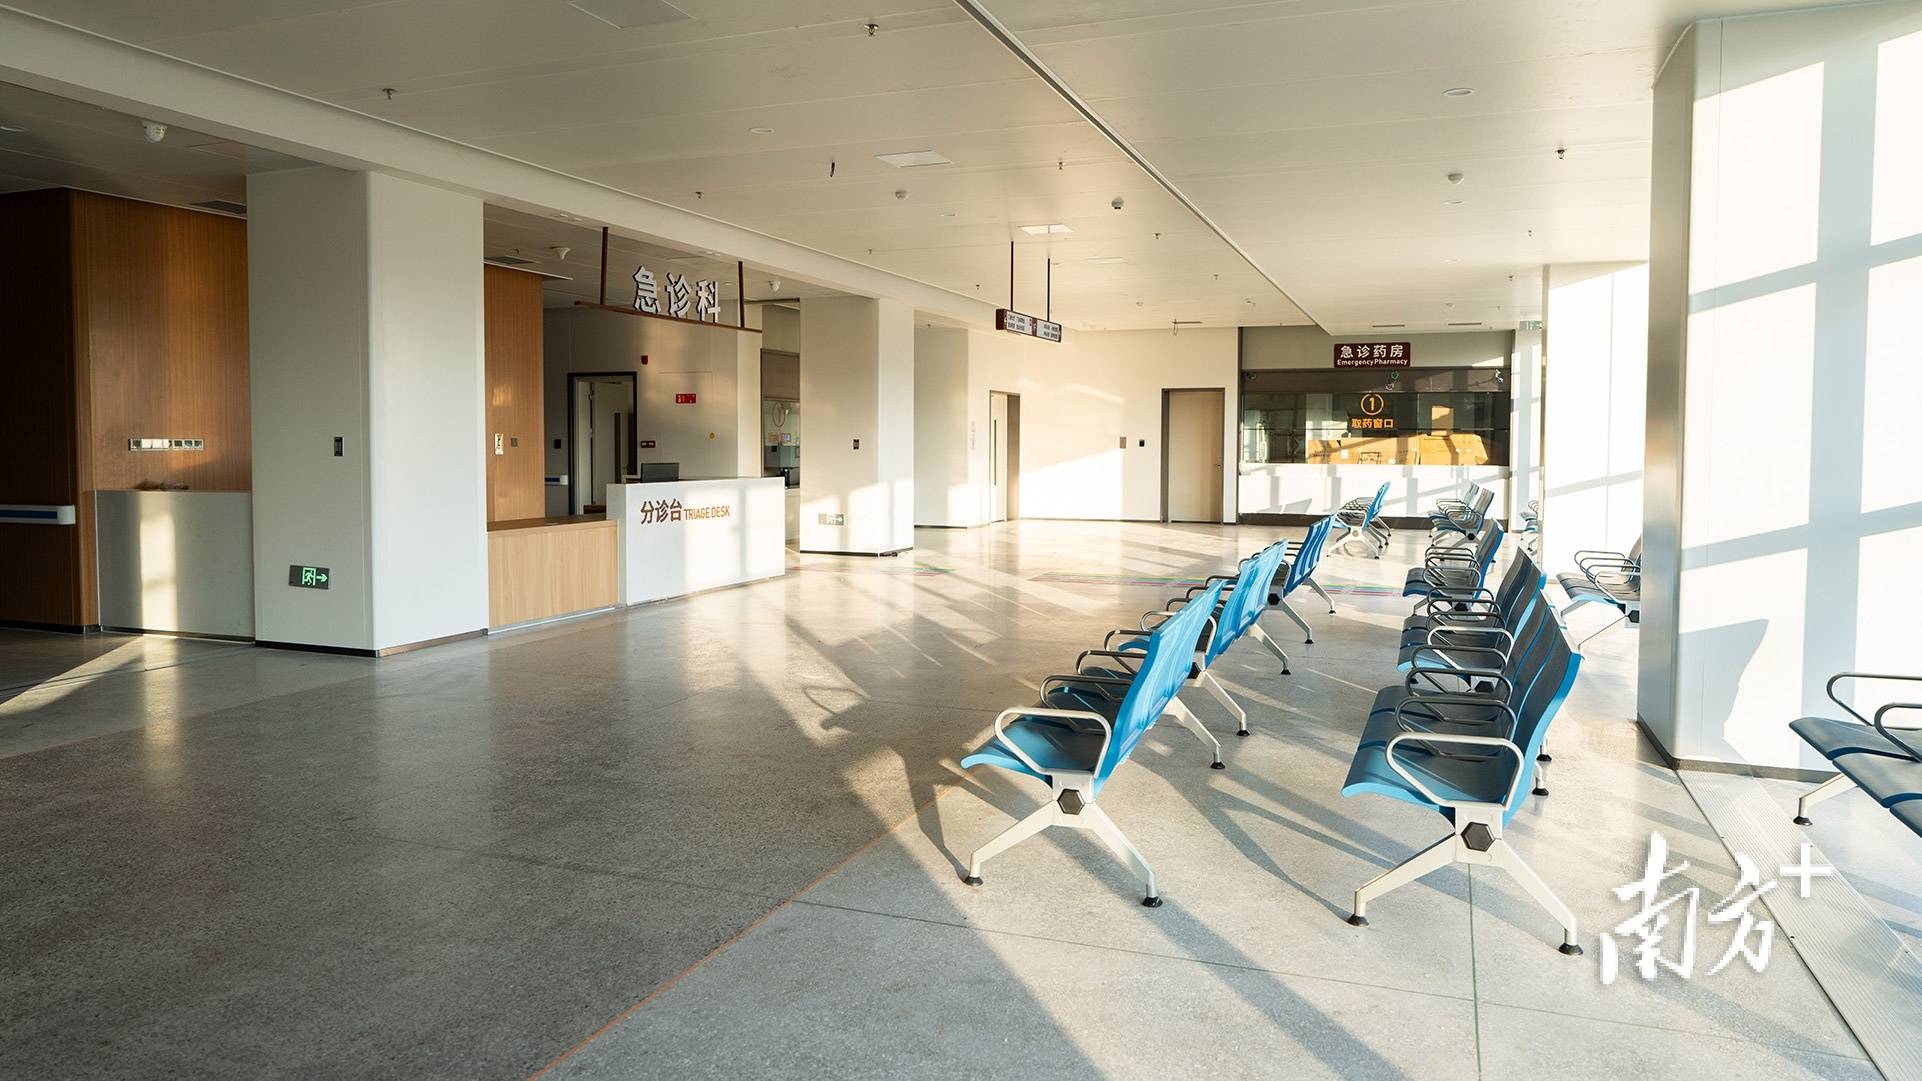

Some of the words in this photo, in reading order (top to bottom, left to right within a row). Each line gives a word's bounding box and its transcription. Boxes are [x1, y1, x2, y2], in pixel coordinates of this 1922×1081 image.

[632, 265, 721, 323] 急诊科
[1340, 344, 1404, 358] 急诊药房
[1336, 359, 1374, 367] Emergency
[1351, 418, 1394, 429] 取药窗口
[640, 499, 682, 524] 分诊台
[684, 507, 710, 520] TRIAGE
[711, 505, 730, 518] DESK
